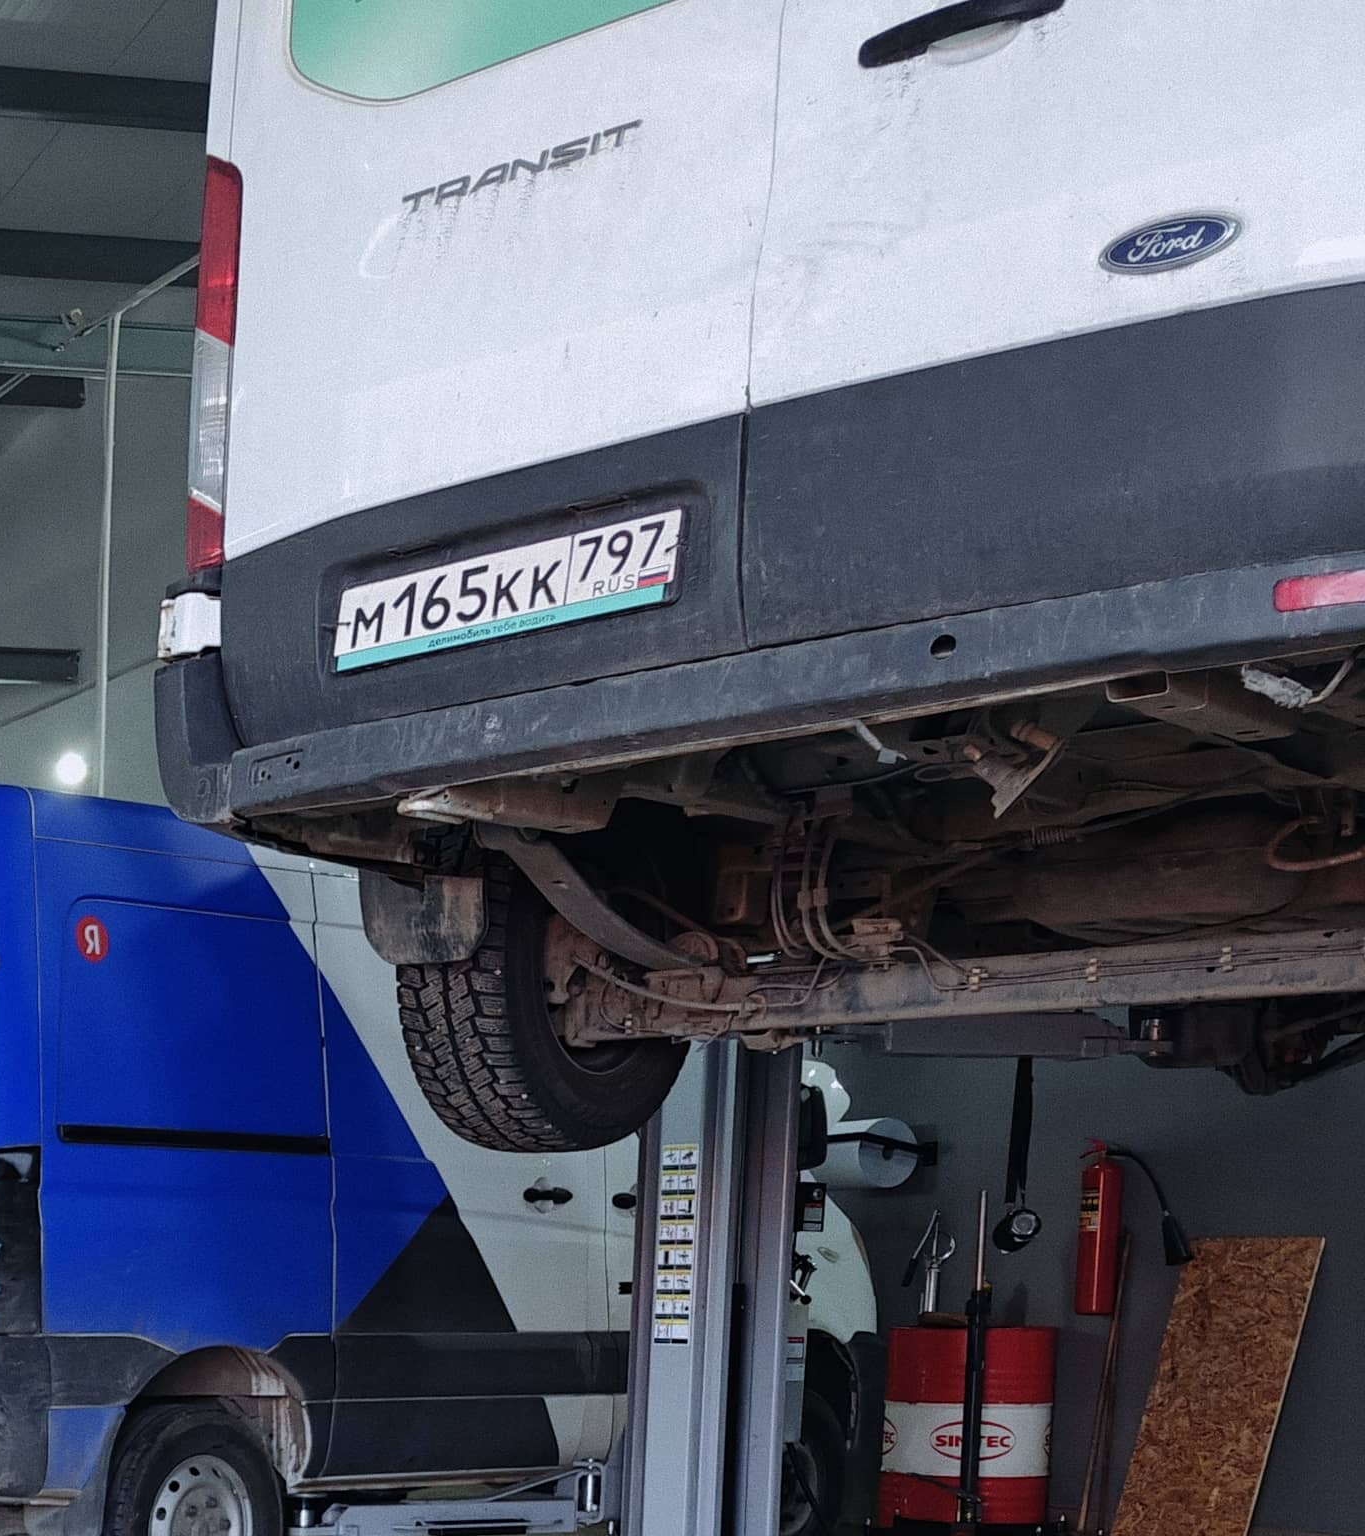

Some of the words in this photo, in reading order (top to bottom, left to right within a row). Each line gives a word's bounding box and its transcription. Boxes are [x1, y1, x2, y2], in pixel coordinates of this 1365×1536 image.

[402, 119, 643, 213] TRANSIT
[1127, 224, 1205, 262] Ford
[350, 559, 563, 649] М165КК
[578, 520, 666, 583] 797
[592, 574, 635, 597] RUS
[427, 629, 491, 648] делимобиль
[84, 924, 101, 955] Я
